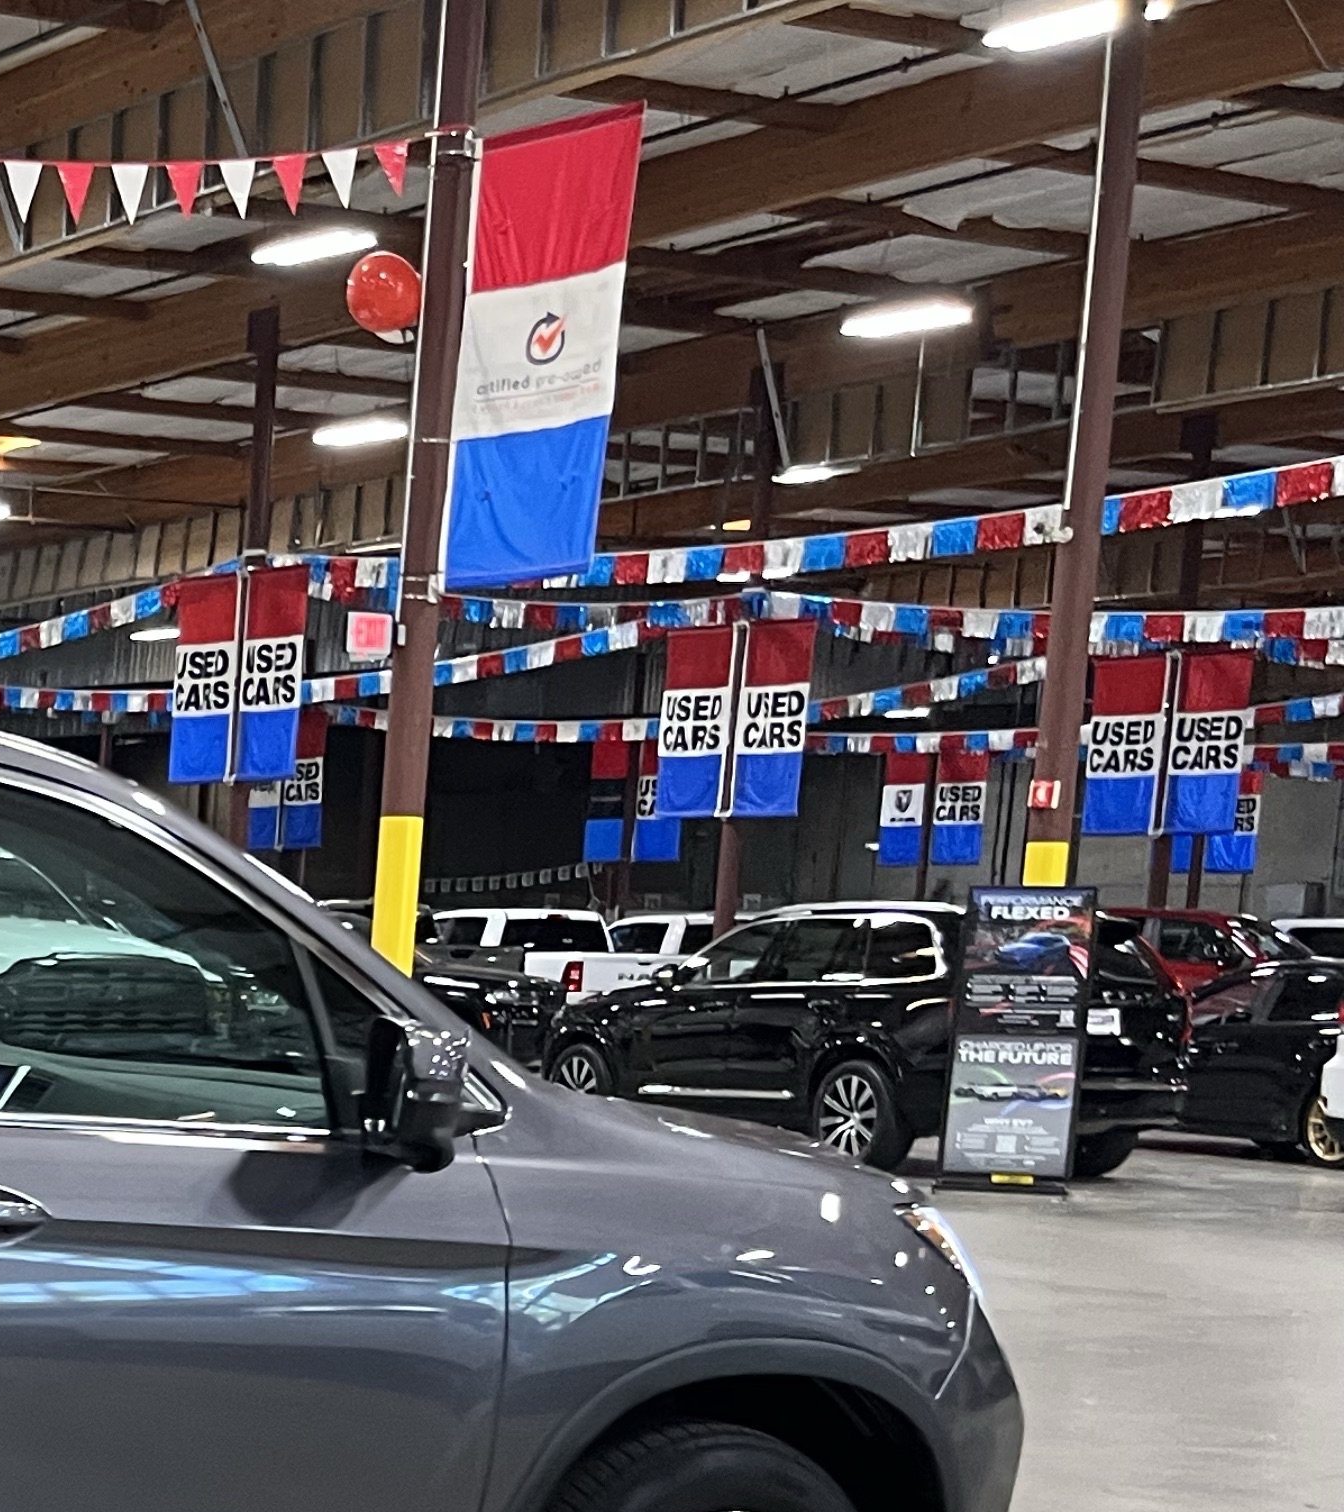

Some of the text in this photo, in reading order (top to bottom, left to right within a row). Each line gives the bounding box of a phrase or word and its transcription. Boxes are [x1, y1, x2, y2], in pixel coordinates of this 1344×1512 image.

[177, 649, 230, 679] USED
[246, 642, 297, 674] USED
[175, 681, 230, 711] CARS
[242, 674, 296, 705] CARS
[666, 695, 722, 721] USED
[747, 691, 805, 718] USED
[663, 724, 720, 751] CARS
[743, 720, 802, 748] CARS
[1092, 720, 1155, 746] USED
[1175, 716, 1243, 742] USED
[1089, 747, 1154, 773] CARS
[1171, 744, 1239, 770] CARS
[295, 762, 320, 780] SED
[939, 786, 982, 802] USED
[935, 804, 981, 822] CARS
[991, 905, 1071, 920] FLEXED
[958, 1049, 1072, 1066] THE FUTURE
